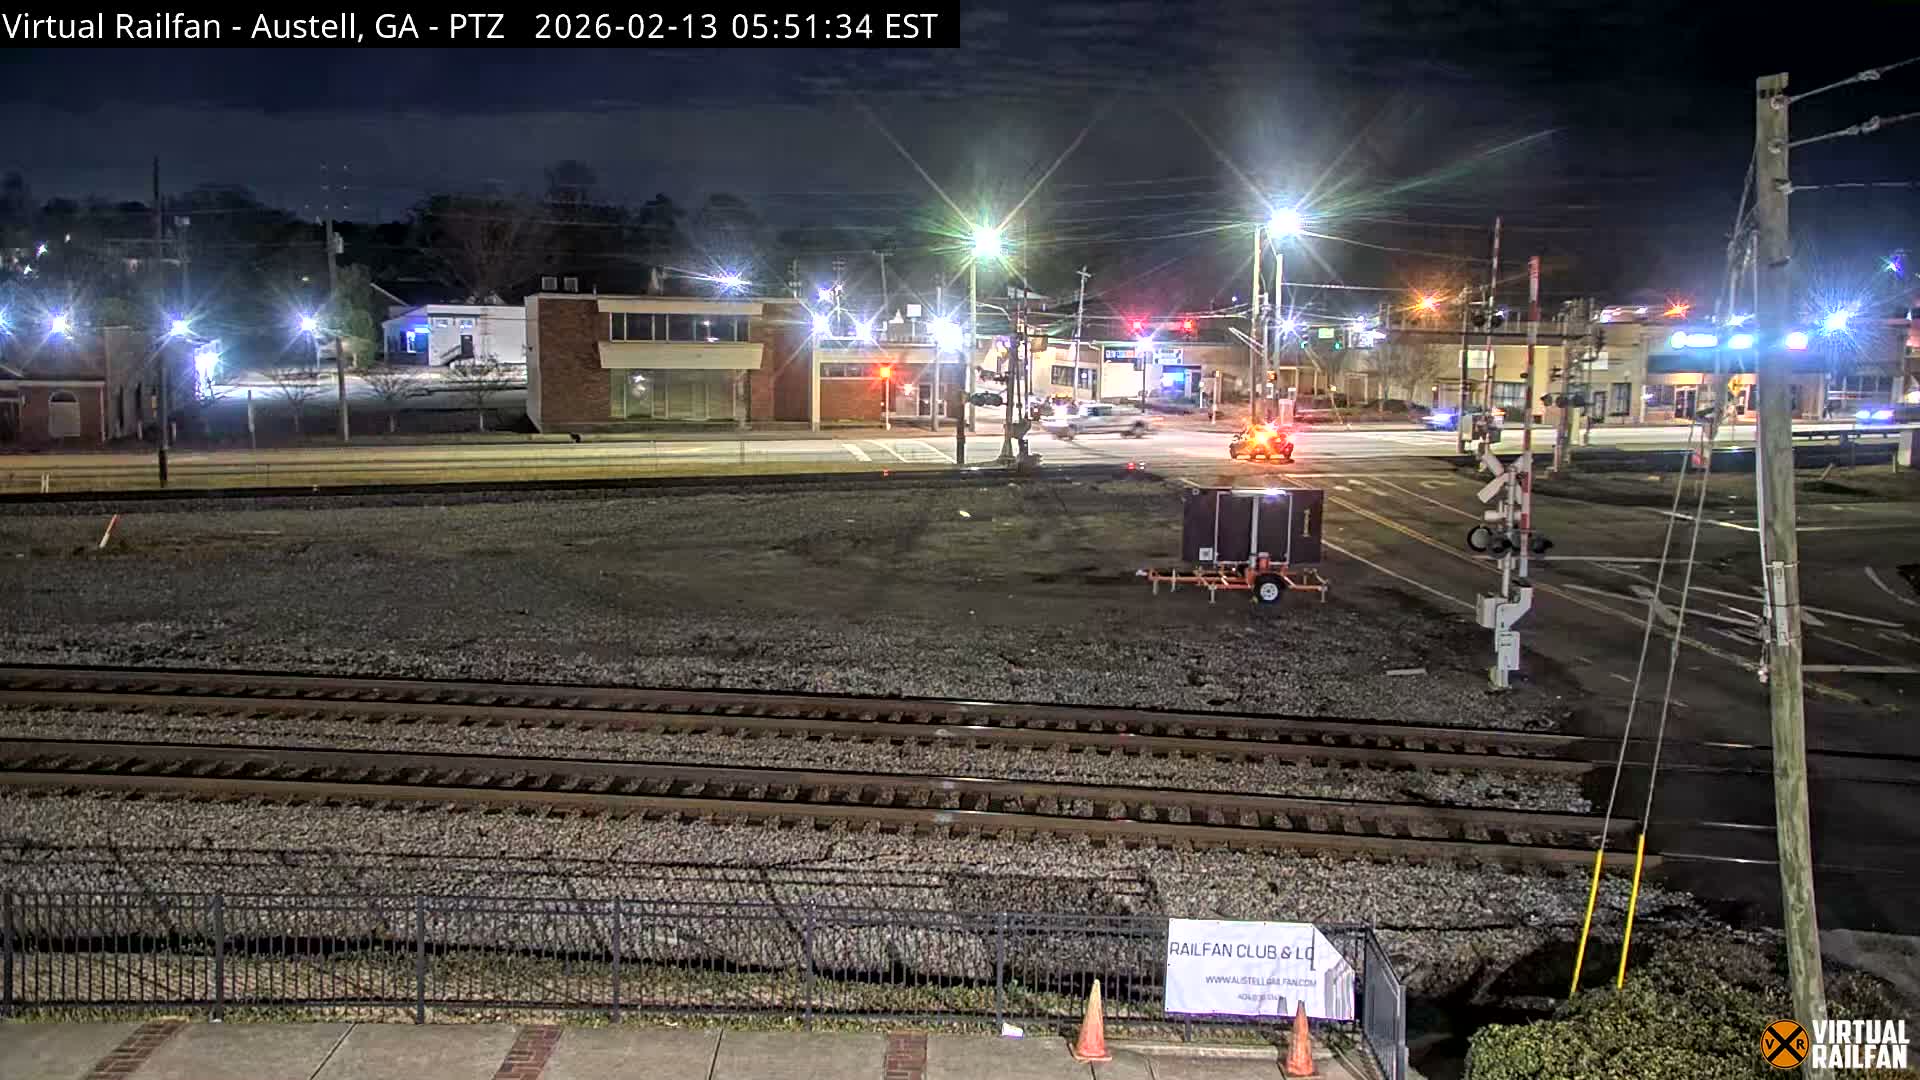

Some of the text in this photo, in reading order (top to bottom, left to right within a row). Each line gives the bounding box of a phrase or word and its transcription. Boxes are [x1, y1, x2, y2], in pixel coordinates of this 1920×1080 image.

[1169, 941, 1233, 957] RAILFAN
[1236, 943, 1277, 960] CLUB
[1280, 946, 1292, 959] &
